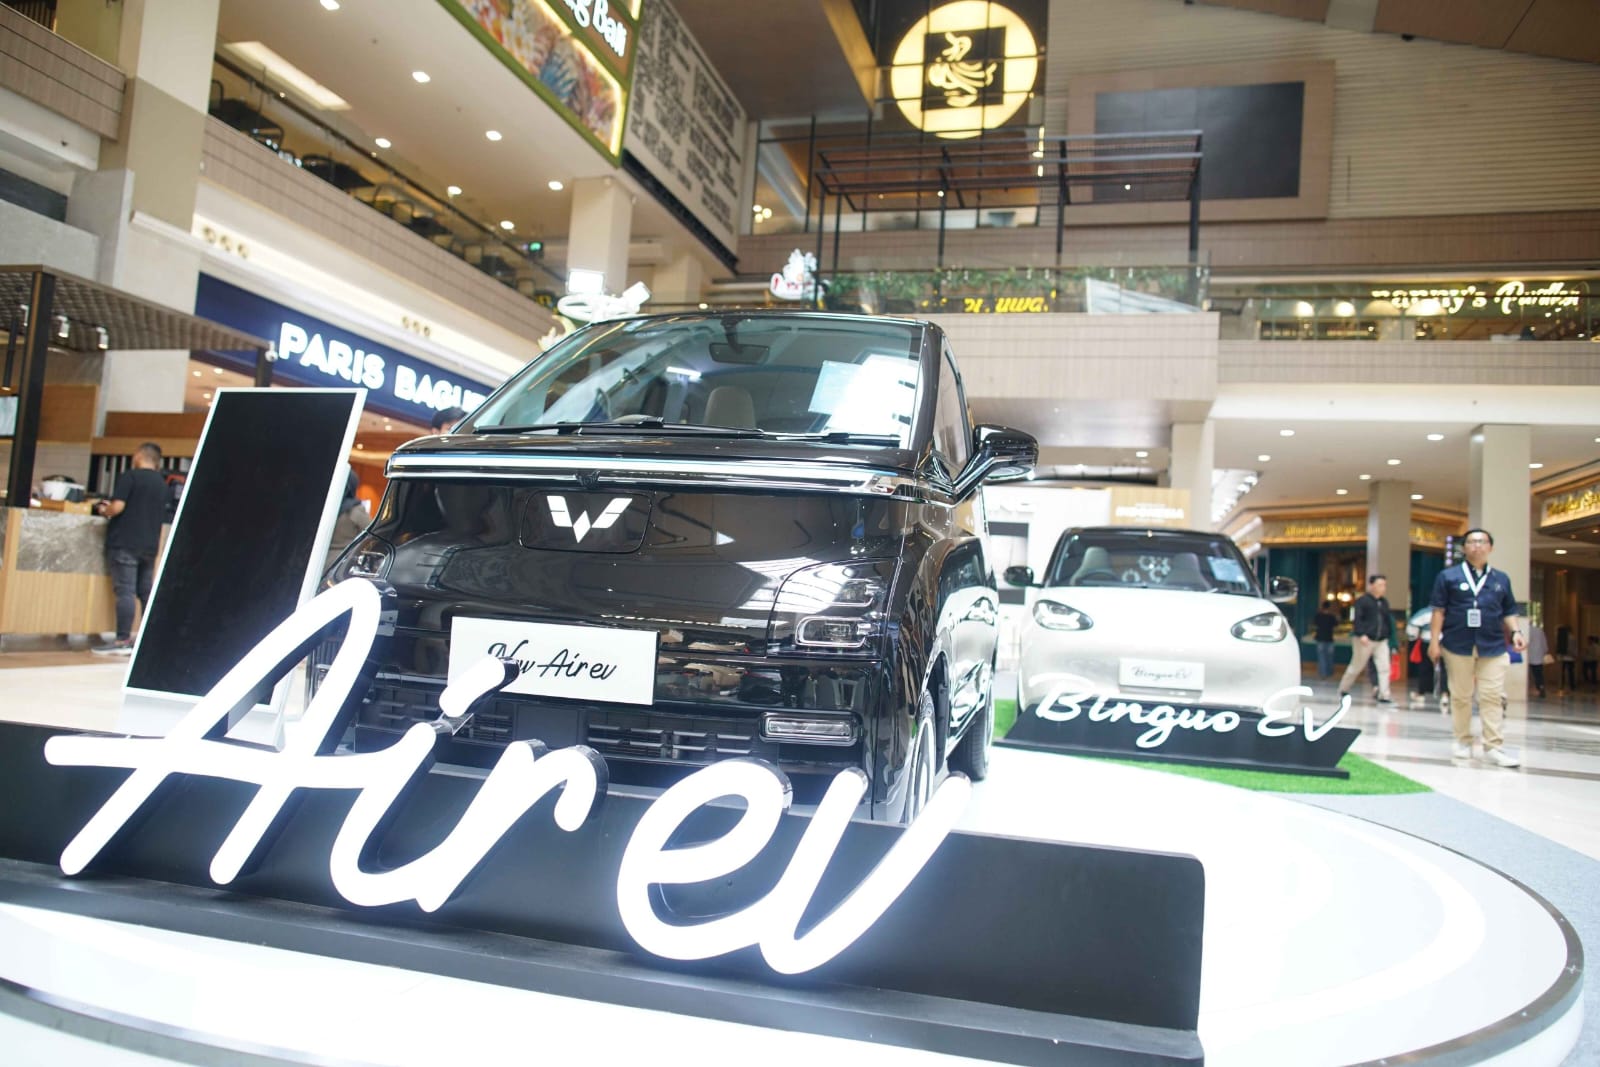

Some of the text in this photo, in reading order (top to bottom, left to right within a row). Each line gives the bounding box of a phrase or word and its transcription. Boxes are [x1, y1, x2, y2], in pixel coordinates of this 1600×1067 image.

[278, 321, 386, 390] PARIS
[487, 639, 536, 674] Nw
[1256, 685, 1352, 742] EV
